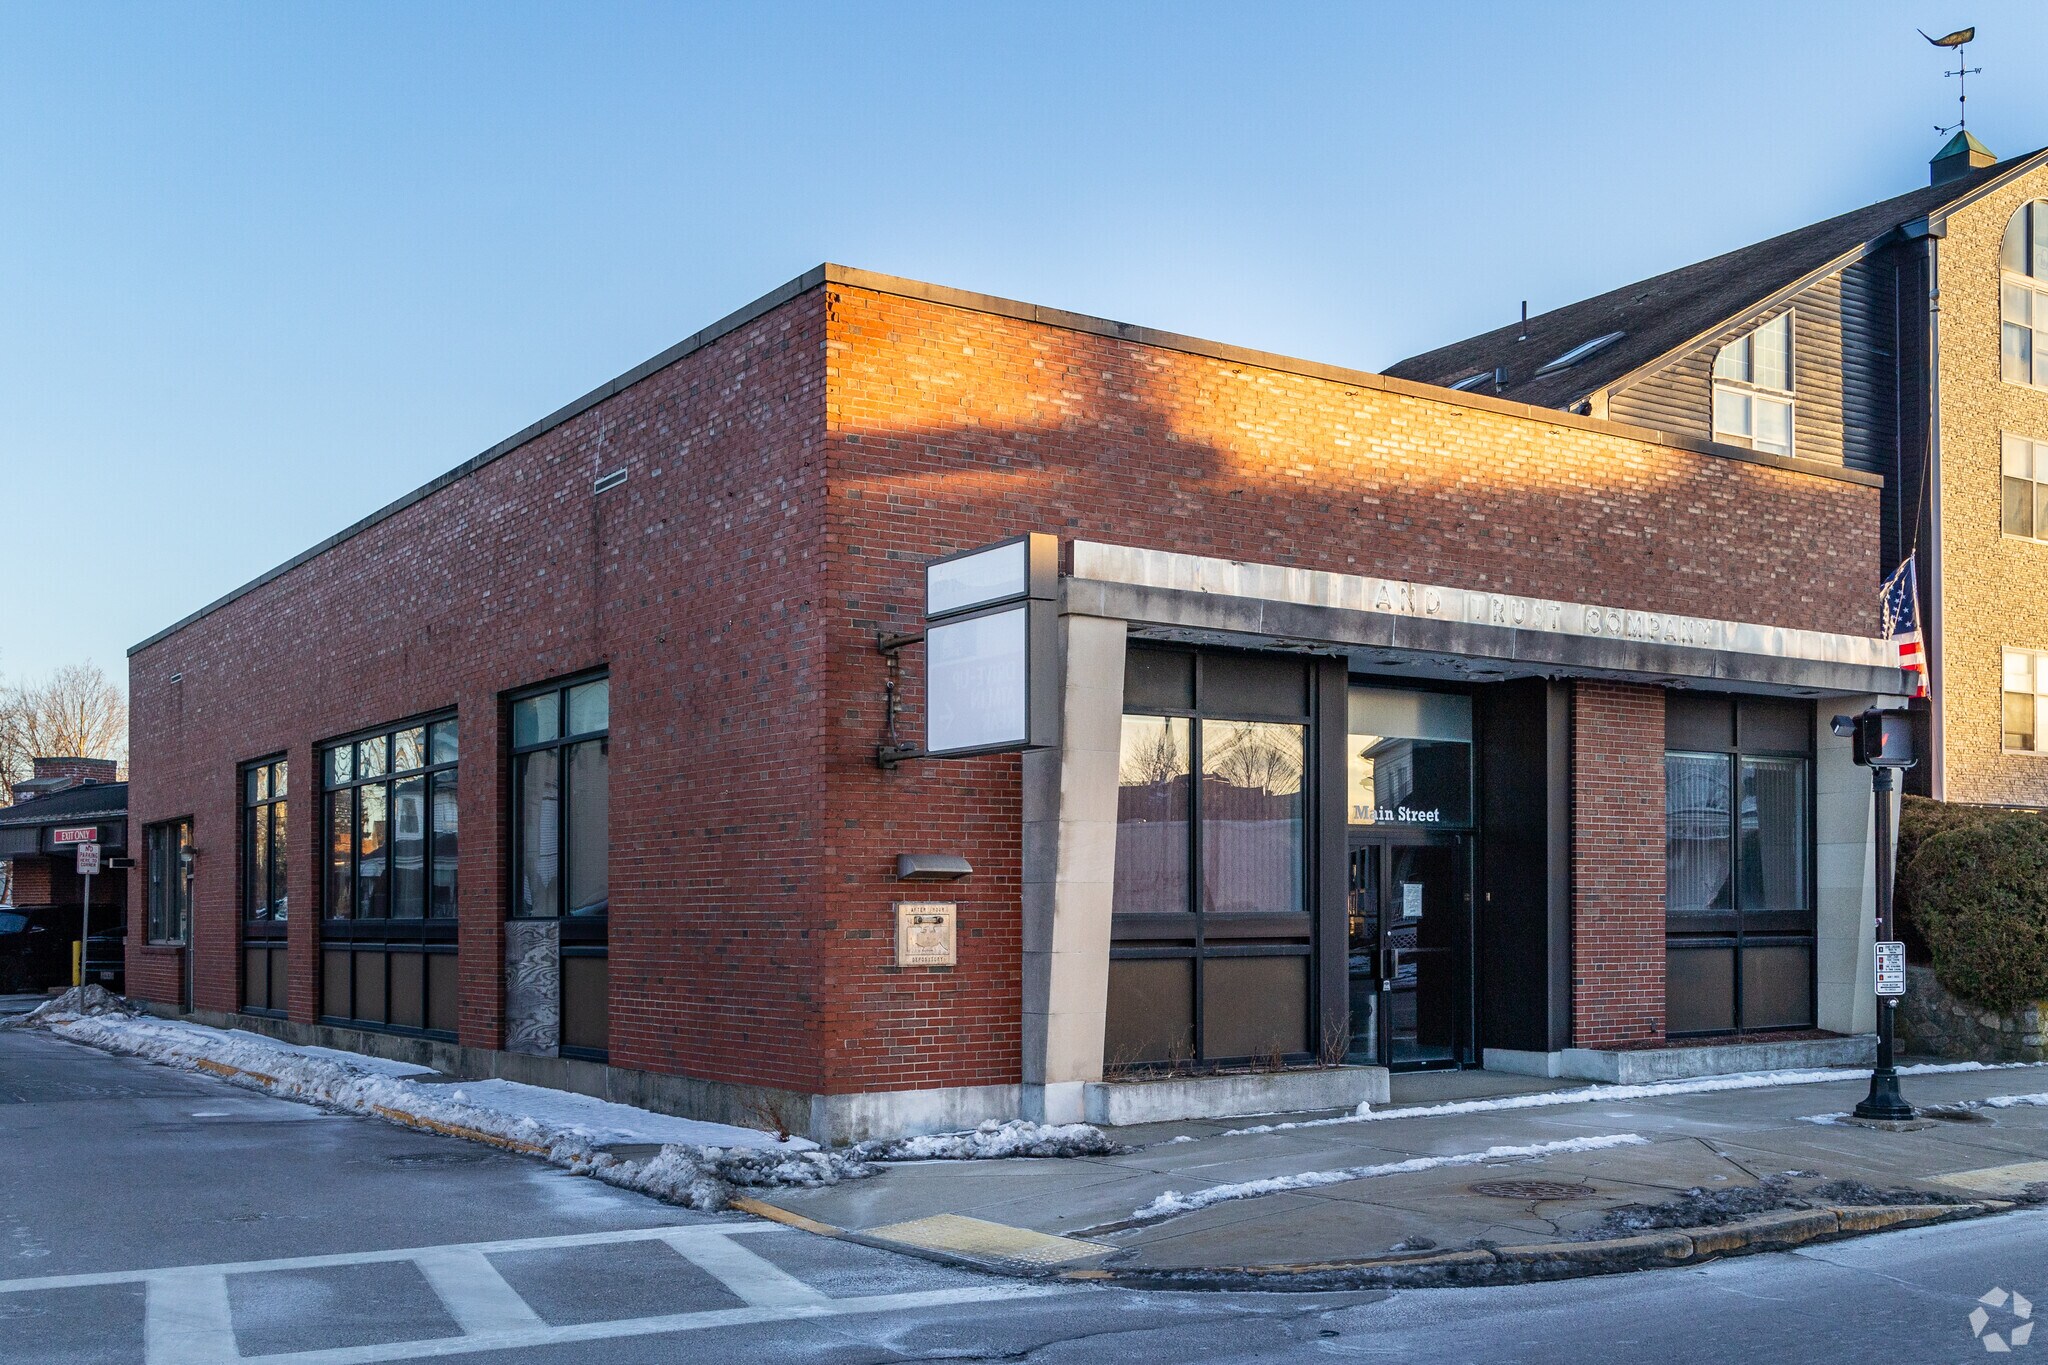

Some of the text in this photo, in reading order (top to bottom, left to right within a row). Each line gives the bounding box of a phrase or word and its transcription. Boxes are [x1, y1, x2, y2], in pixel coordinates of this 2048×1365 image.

[1375, 584, 1711, 645] AND TRUST COMPANY
[1353, 805, 1439, 822] Main Street
[62, 830, 90, 840] EXIT ONLY
